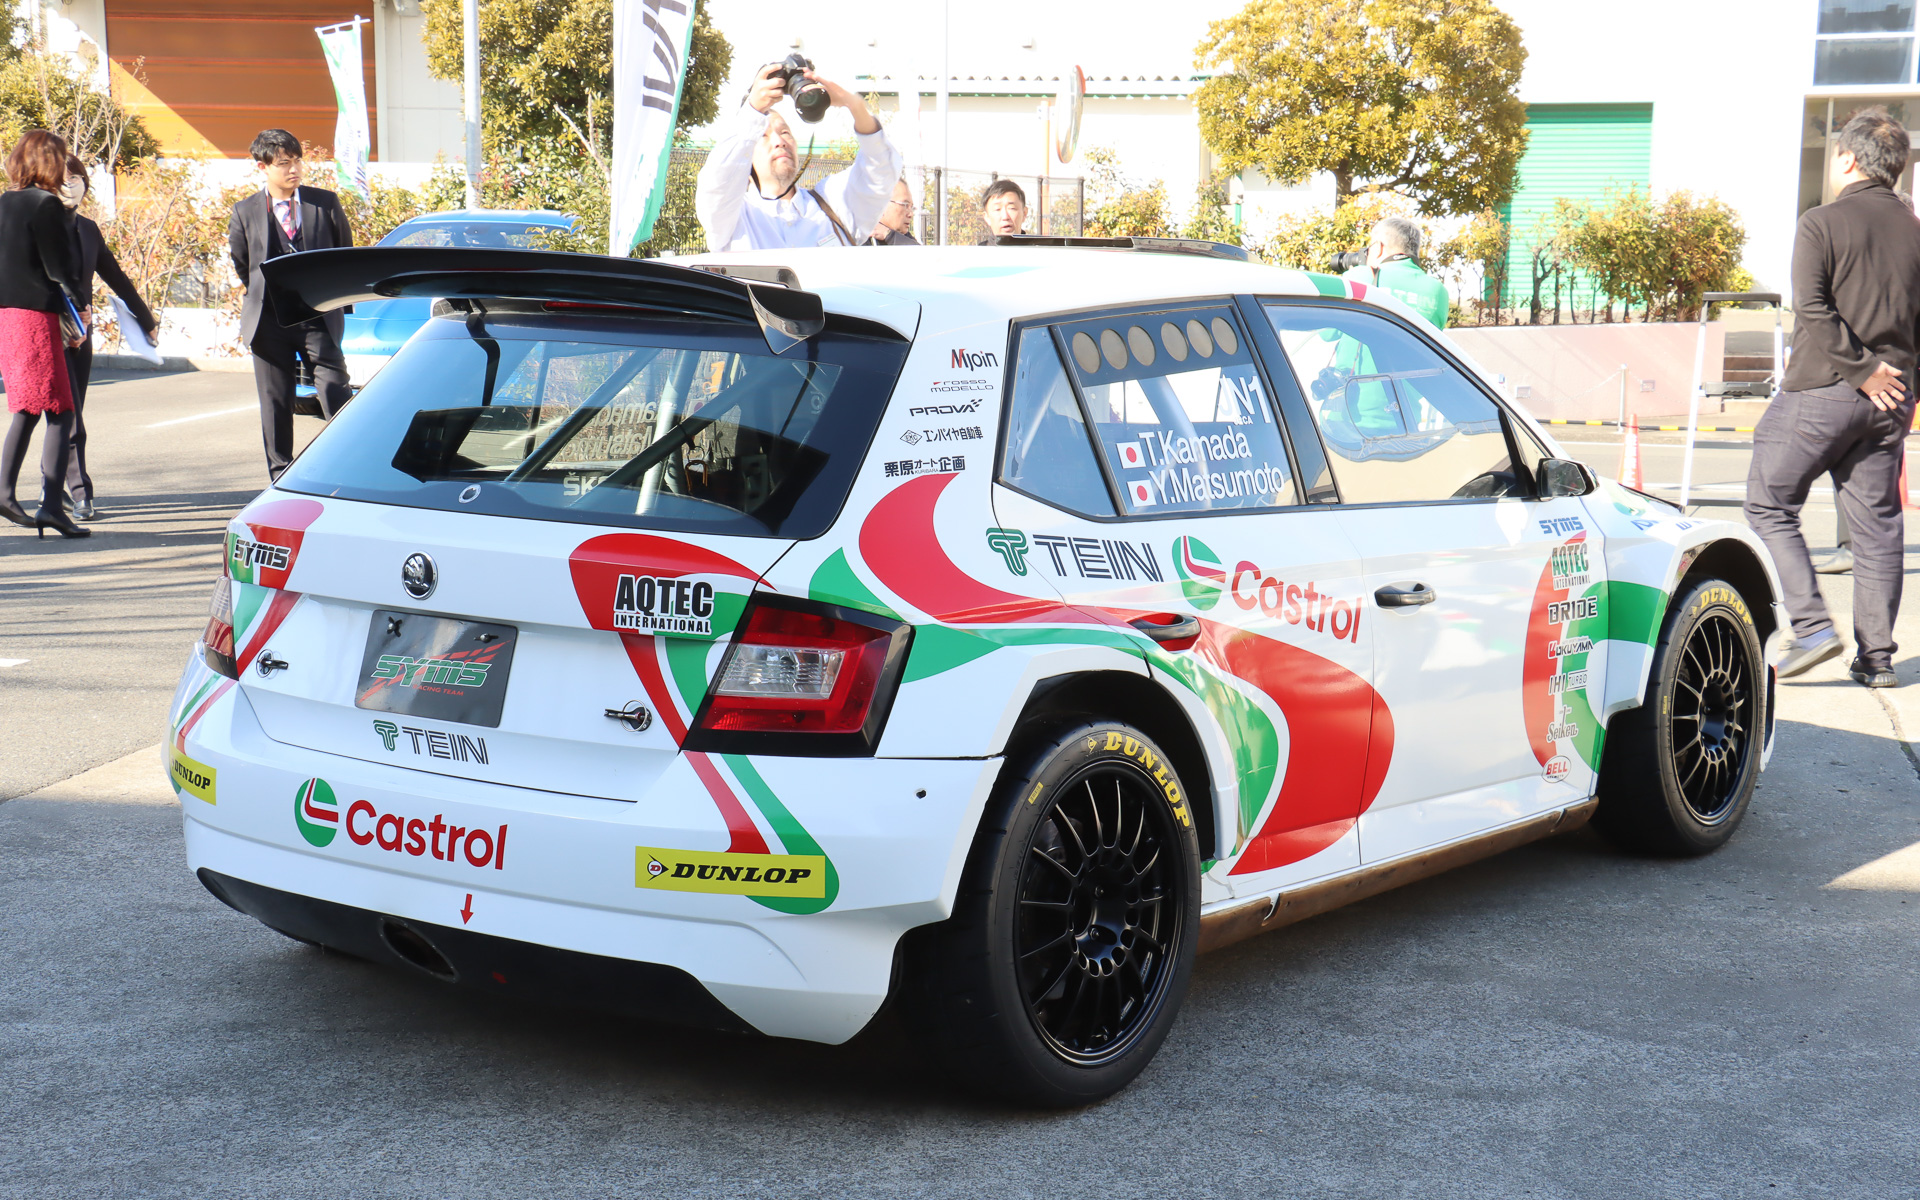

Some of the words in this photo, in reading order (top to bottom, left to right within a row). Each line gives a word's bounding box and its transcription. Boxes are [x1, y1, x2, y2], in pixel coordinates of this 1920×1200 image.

[951, 349, 999, 372] Mjoin
[909, 403, 976, 418] PROVA
[922, 426, 984, 443] エンバイヤ自動車
[1138, 425, 1252, 467] T.Kamada
[1148, 462, 1285, 505] Y.Matsumoto
[1538, 516, 1584, 537] SYMS
[234, 539, 290, 569] SYMS
[1032, 534, 1165, 583] TEIN
[1552, 543, 1589, 578] AQTEC
[615, 576, 713, 618] AQTEC
[1553, 574, 1591, 590] INTERNATIONAL
[1231, 560, 1363, 644] Castrol
[1549, 597, 1597, 624] BRIDE
[1700, 587, 1753, 625] DUNLOP
[615, 614, 711, 634] INTERNATIONAL
[370, 654, 493, 688] SYMS
[1549, 675, 1566, 694] IHI
[412, 684, 441, 694] RACING
[443, 688, 465, 697] TEAM
[1547, 706, 1578, 742] Seiken
[402, 726, 489, 766] TEIN
[174, 759, 211, 790] DUNLOP
[1103, 731, 1190, 828] DUNLOP
[1546, 761, 1568, 776] BELL
[346, 800, 508, 871] Castrol
[671, 863, 811, 884] DUNLOP
